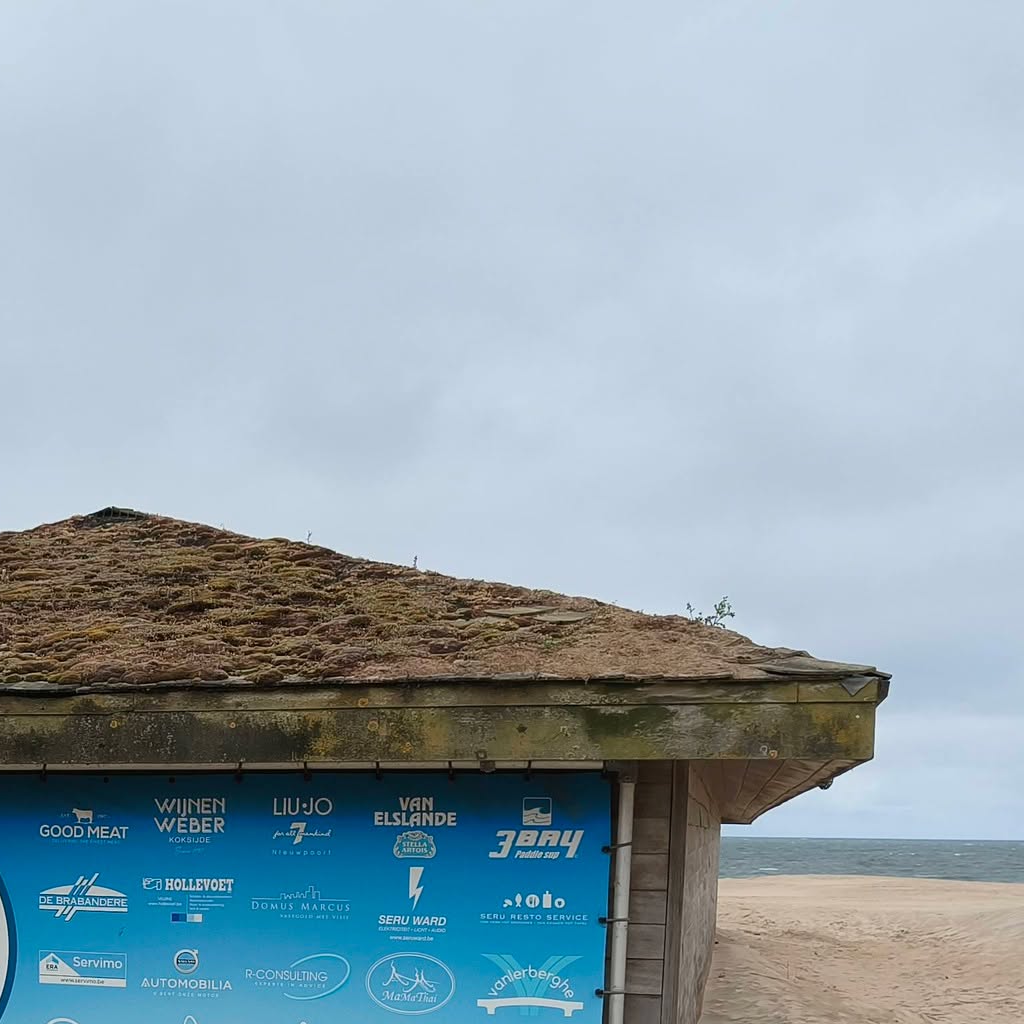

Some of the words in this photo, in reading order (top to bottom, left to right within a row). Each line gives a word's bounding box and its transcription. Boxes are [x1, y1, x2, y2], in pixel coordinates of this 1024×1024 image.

[154, 798, 226, 817] WIJNEN
[398, 796, 434, 812] VAN
[154, 817, 225, 834] WEBER
[374, 811, 457, 828] ELSLANDE
[40, 824, 84, 838] GOOD
[87, 826, 128, 839] MEAT
[272, 830, 284, 839] for
[169, 836, 211, 844] KOKSIJDE
[164, 878, 234, 892] HOLLEVOET
[39, 896, 54, 904] DE
[56, 896, 128, 907] BRABANDERE
[251, 900, 294, 910] DOMUS
[300, 902, 351, 912] MARCUS
[378, 914, 410, 925] SERU
[412, 916, 447, 926] WARD
[72, 956, 123, 969] Servimo
[245, 968, 328, 982] R-CONSULTING
[488, 964, 574, 998] vanlerberghe
[140, 978, 232, 990] AUTOMOBILIA
